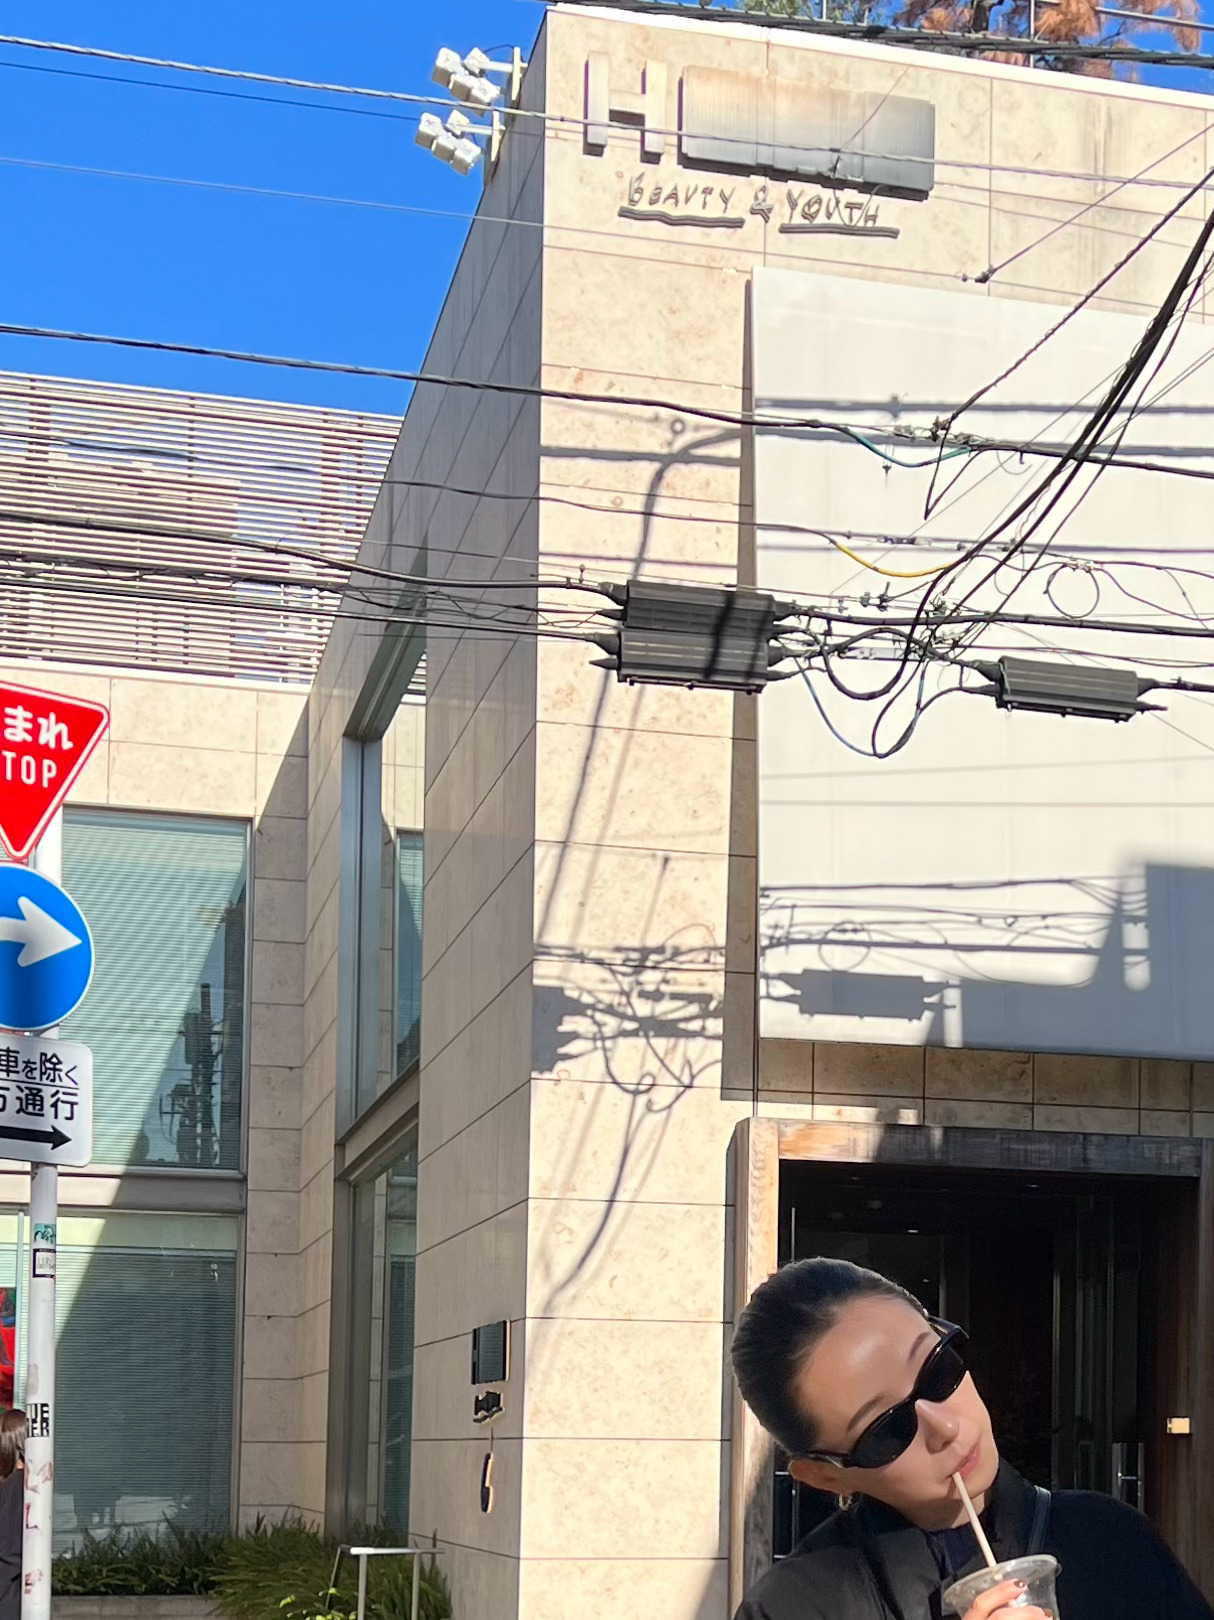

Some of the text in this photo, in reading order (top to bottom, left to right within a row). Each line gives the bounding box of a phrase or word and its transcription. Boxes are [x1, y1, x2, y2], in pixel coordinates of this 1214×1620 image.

[583, 51, 667, 160] H
[629, 171, 880, 227] BEAUTY & YOUTH
[4, 705, 74, 751] まれ
[2, 750, 57, 789] TOP
[0, 1046, 78, 1086] 車を除く
